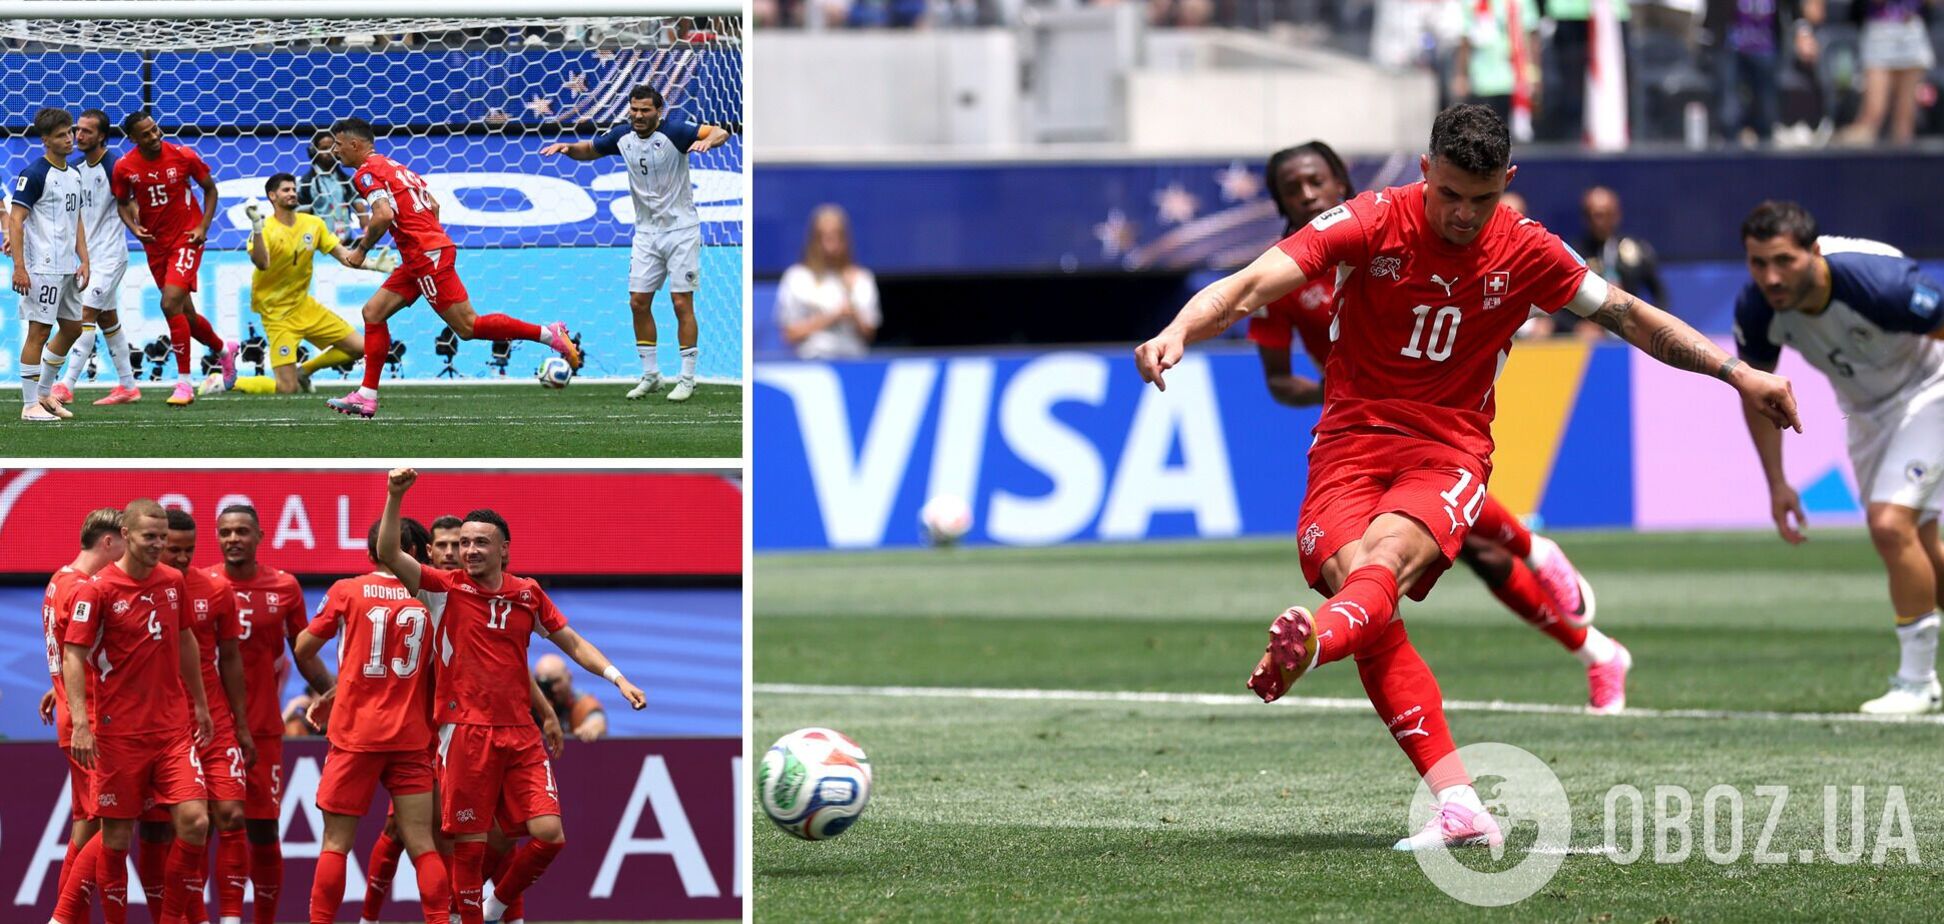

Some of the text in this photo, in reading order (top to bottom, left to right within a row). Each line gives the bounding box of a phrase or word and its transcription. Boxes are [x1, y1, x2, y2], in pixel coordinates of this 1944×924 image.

[639, 157, 649, 176] 5
[65, 193, 77, 212] 20
[147, 184, 169, 207] 15
[175, 247, 196, 270] 15
[39, 285, 58, 305] 20
[417, 275, 438, 300] 10
[1400, 304, 1462, 362] 10
[753, 352, 1242, 549] VISA
[1440, 467, 1486, 527] 10
[147, 609, 162, 640] 4
[238, 608, 254, 640] 5
[487, 598, 512, 630] 17
[363, 605, 427, 678] 13
[189, 745, 204, 776] 4
[270, 764, 281, 795] 5
